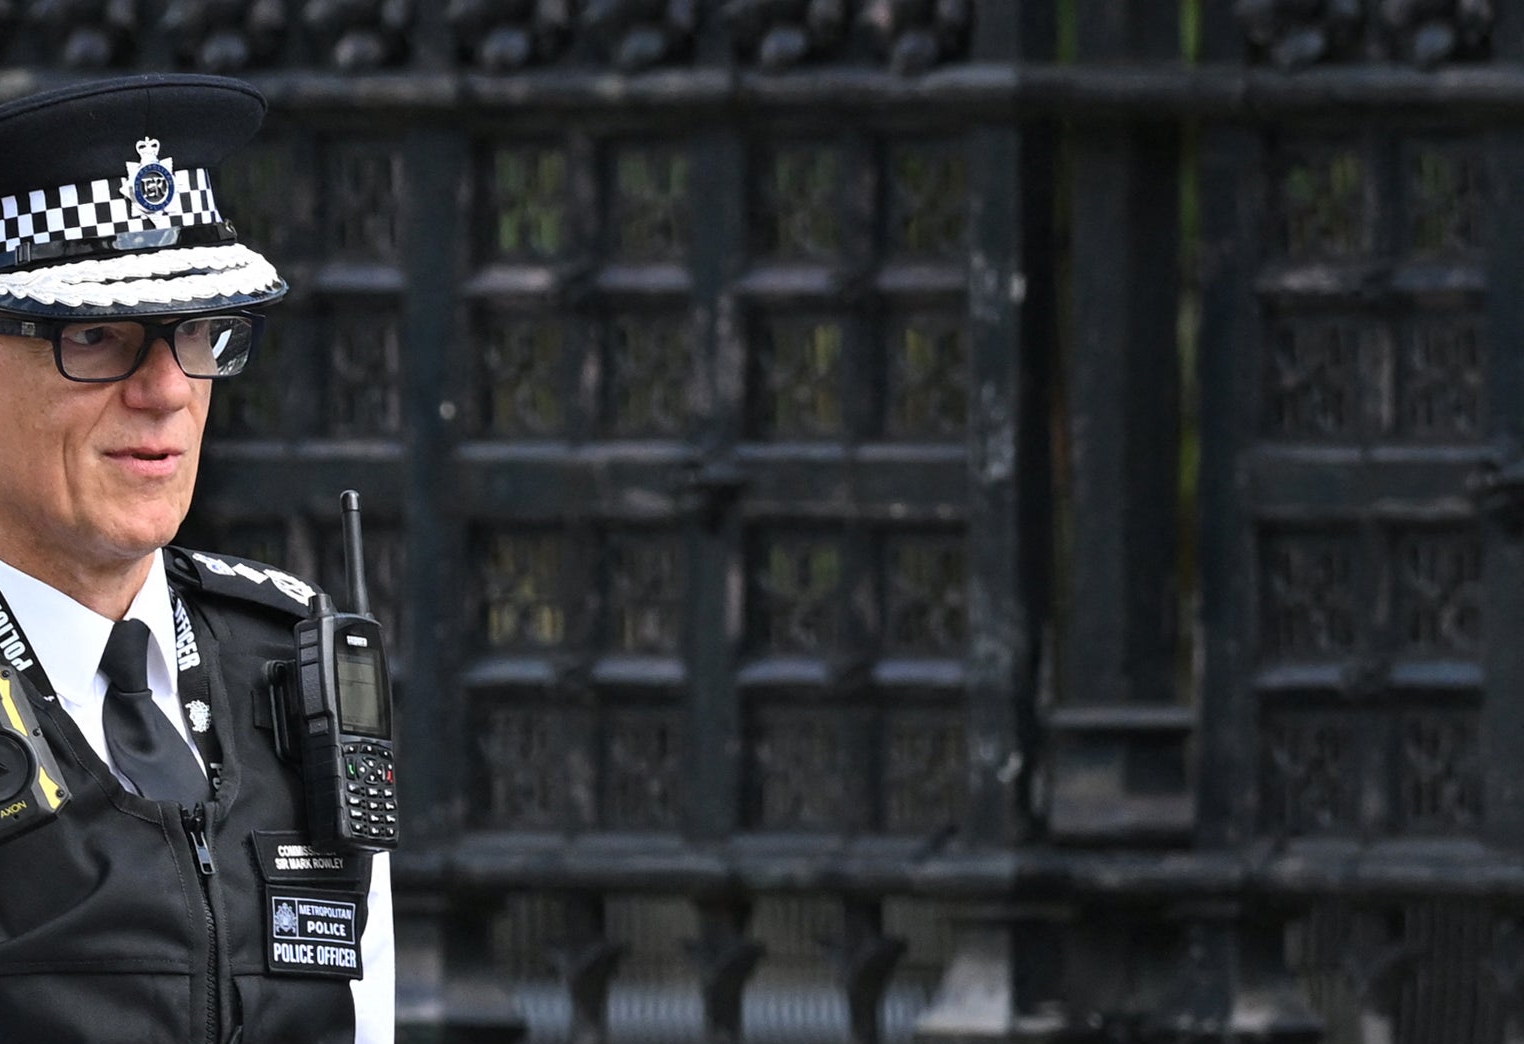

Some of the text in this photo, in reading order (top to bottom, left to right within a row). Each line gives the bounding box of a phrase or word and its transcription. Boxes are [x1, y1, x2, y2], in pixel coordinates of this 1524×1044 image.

[0, 800, 28, 819] AXON
[275, 858, 344, 870] SIR MARK ROWLEY
[299, 904, 352, 920] METROPOLITAN
[307, 921, 346, 936] POLICE
[273, 942, 357, 968] POLICE OFFICER
